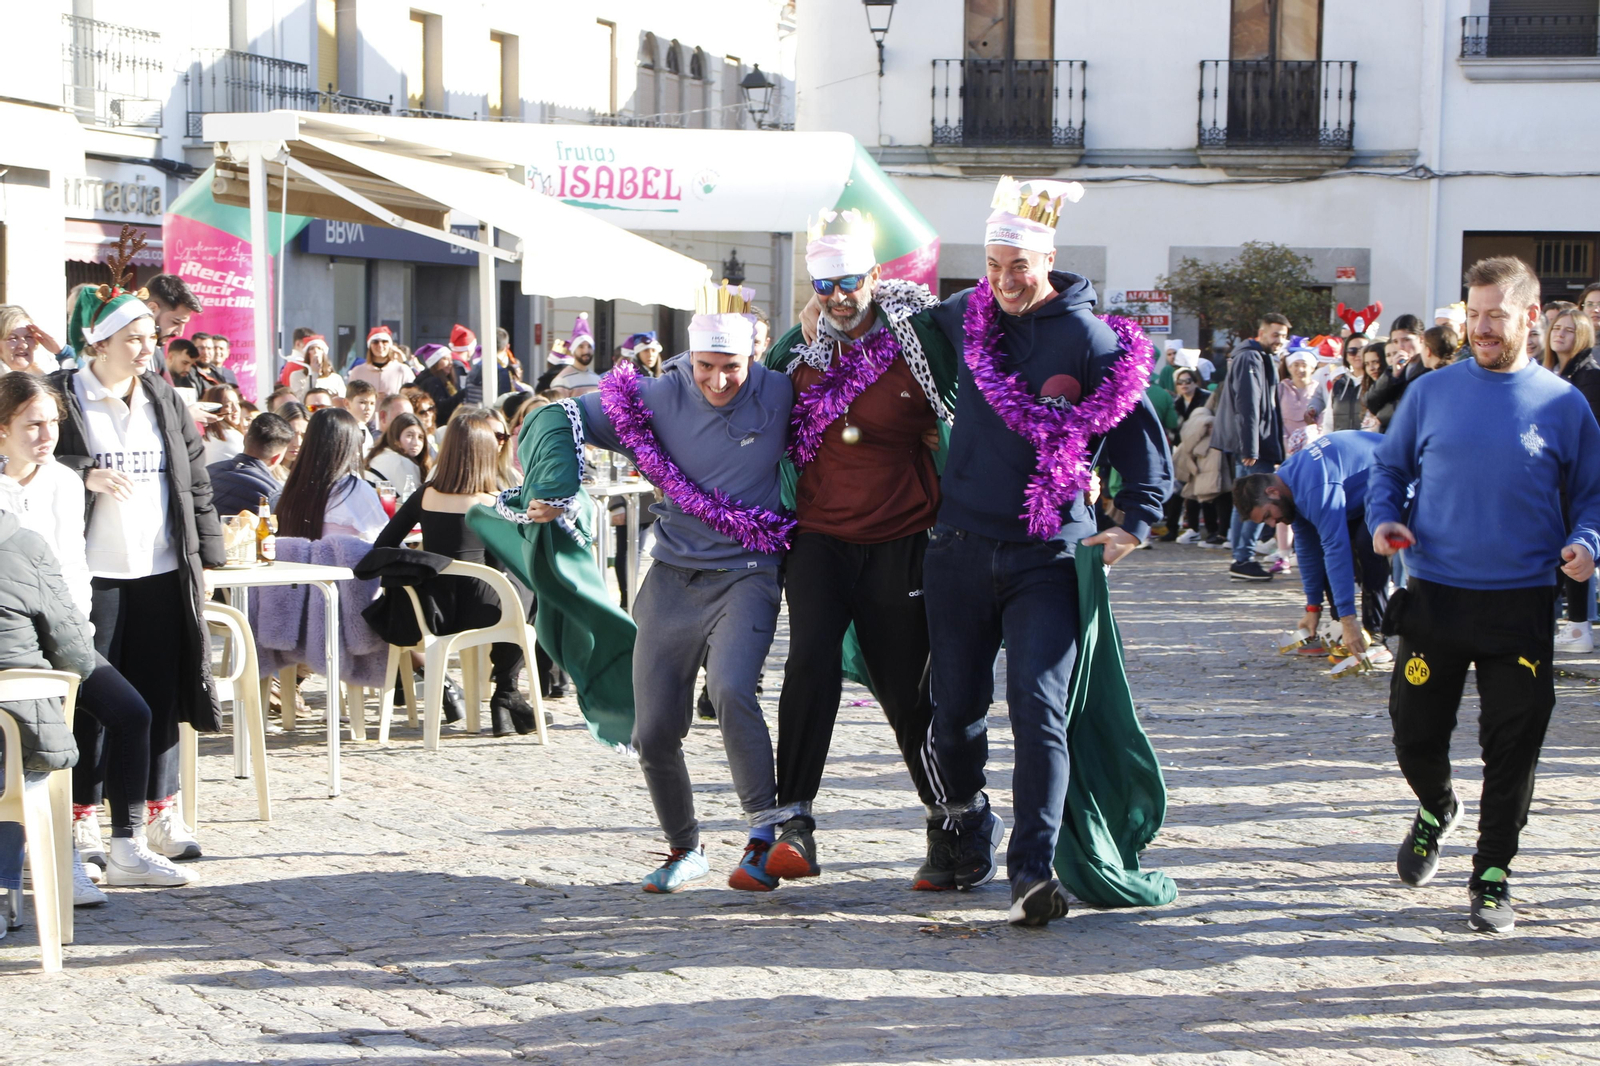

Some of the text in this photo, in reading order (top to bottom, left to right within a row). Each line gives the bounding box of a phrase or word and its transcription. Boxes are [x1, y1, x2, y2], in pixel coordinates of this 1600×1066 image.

[556, 140, 615, 162] frutas
[556, 164, 682, 201] ISABEL
[65, 177, 163, 216] rmacia
[325, 220, 364, 244] BBVA
[188, 281, 236, 296] ducir
[1408, 660, 1427, 677] BVB
